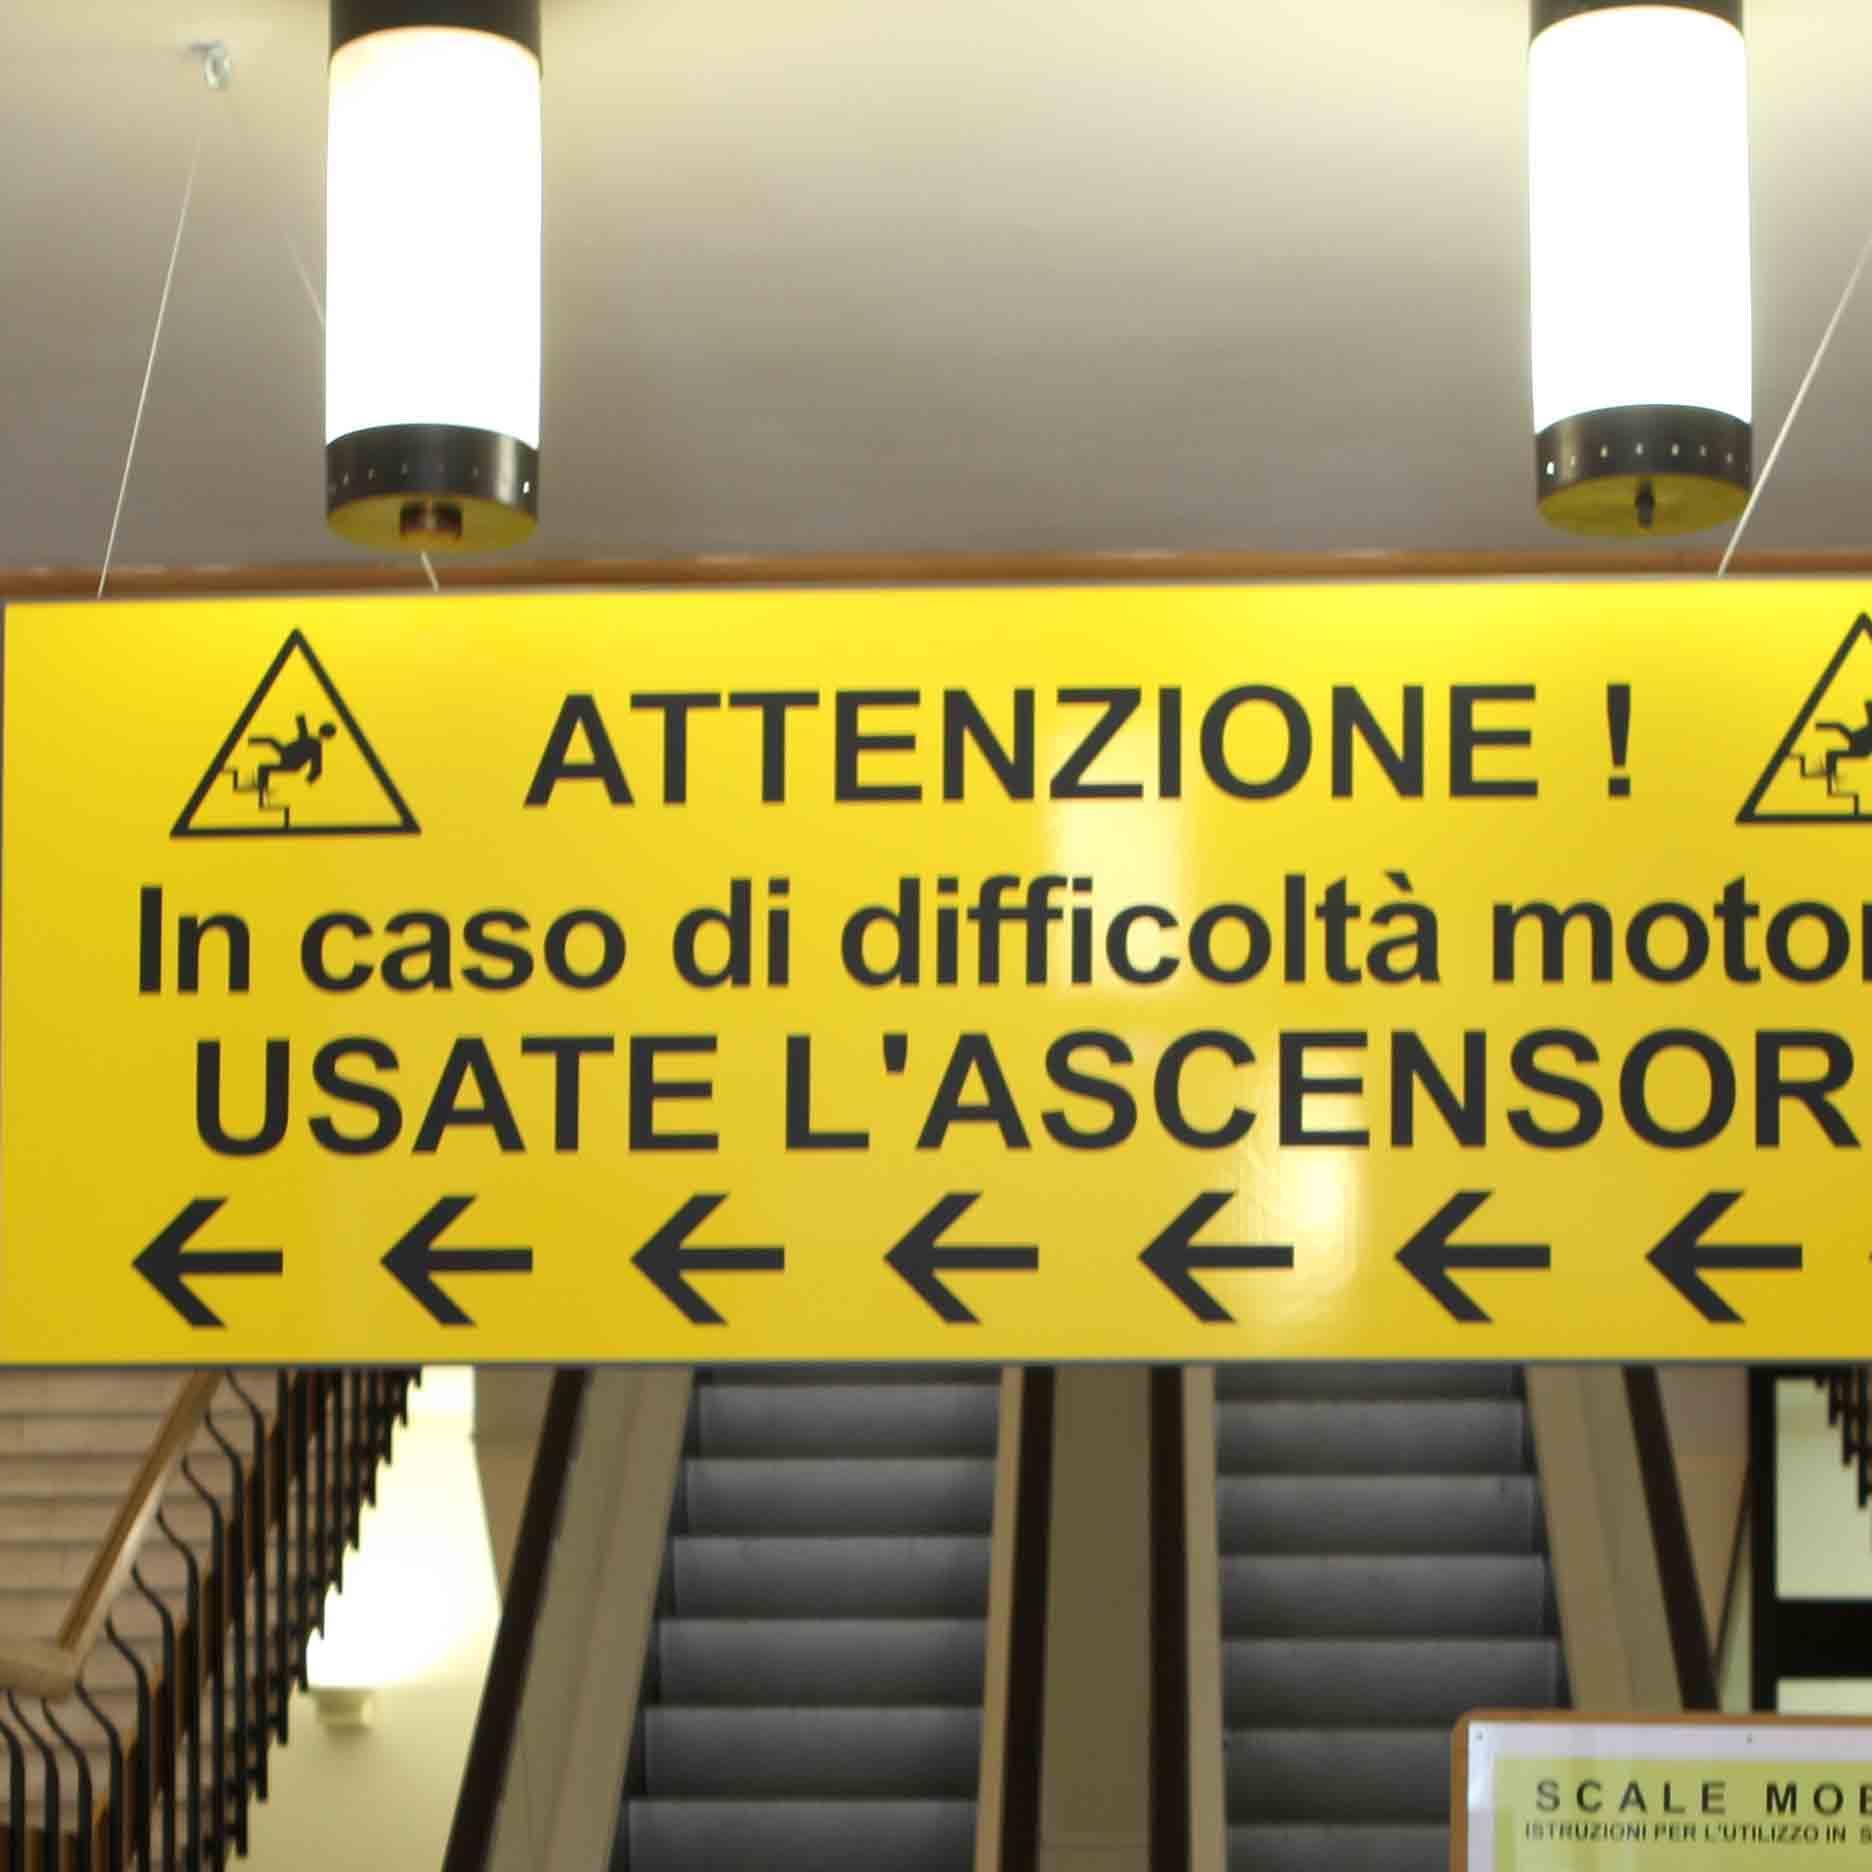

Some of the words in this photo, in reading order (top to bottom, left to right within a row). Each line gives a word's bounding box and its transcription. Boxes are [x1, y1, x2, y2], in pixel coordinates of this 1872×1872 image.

[526, 685, 1538, 805] ATTENZIONE
[1607, 684, 1631, 796] !
[139, 886, 250, 993] In
[301, 909, 626, 992] caso
[673, 879, 789, 988] di
[841, 872, 1440, 986] difficoltà
[196, 1035, 719, 1157] USATE
[1525, 1823, 1647, 1842] ISTRUZIONI
[1654, 1824, 1697, 1842] PER
[1704, 1823, 1820, 1844] L'UTILIZZO
[1826, 1825, 1846, 1843] IN
[1536, 1779, 1727, 1815] SCALE
